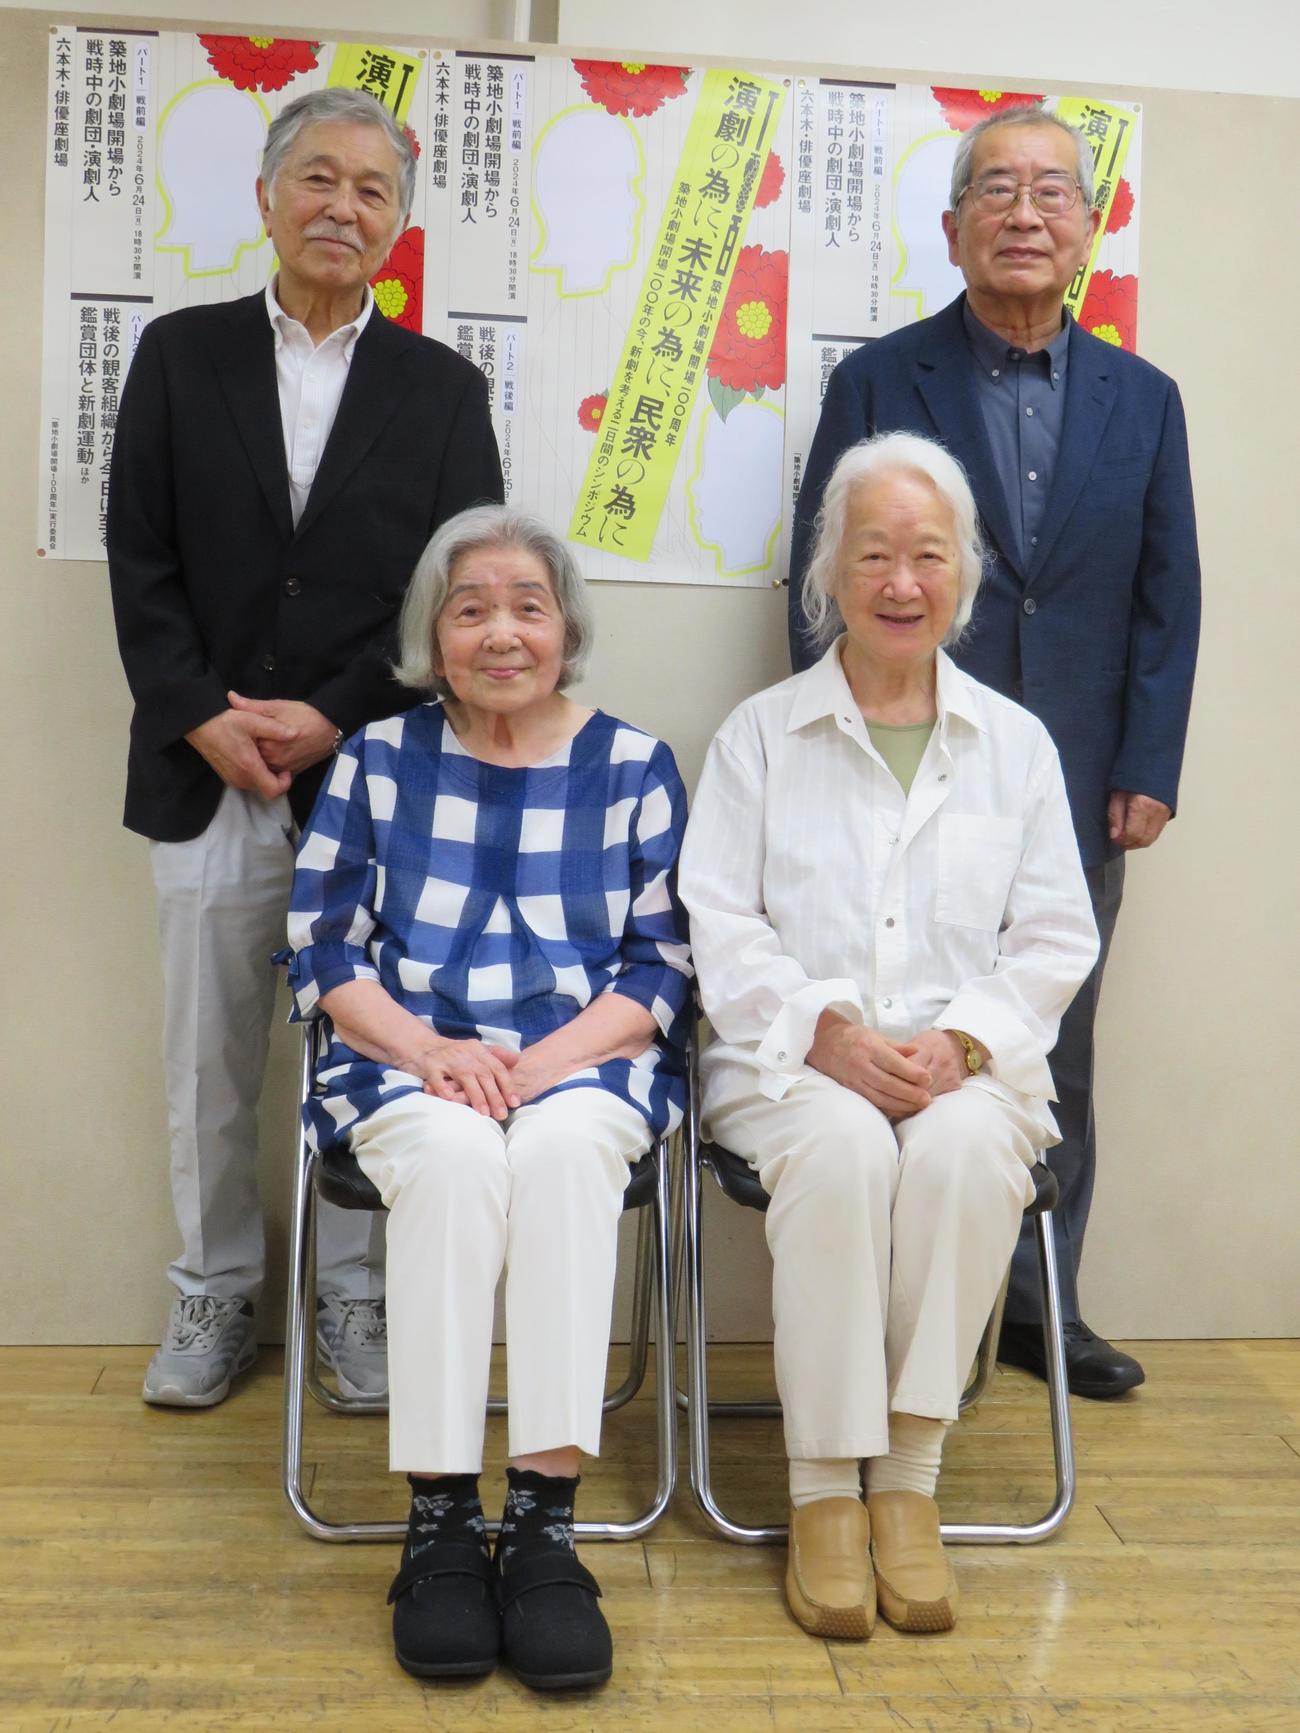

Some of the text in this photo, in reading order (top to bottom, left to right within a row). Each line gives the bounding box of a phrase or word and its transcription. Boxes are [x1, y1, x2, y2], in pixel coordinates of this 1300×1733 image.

[54, 37, 71, 167] 六本木・俳優座劇場
[83, 39, 104, 202] 戦時中の劇団・演劇人
[107, 40, 127, 196] 築地小劇場開場から
[136, 95, 146, 127] 戦前編
[433, 62, 450, 189] 六本木・俳優座劇場
[461, 64, 481, 224] 戦時中の劇団・演劇人
[484, 65, 503, 218] 築地小劇場開場から
[512, 120, 521, 150] 戦前編
[798, 89, 814, 213] 六本木・俳優座劇場
[825, 91, 844, 248] 戦時中の劇団・演劇人
[847, 92, 865, 242] 築地小劇場開場から
[77, 306, 98, 465] 鑑賞団体と新劇運動
[503, 380, 514, 411] 戦後編
